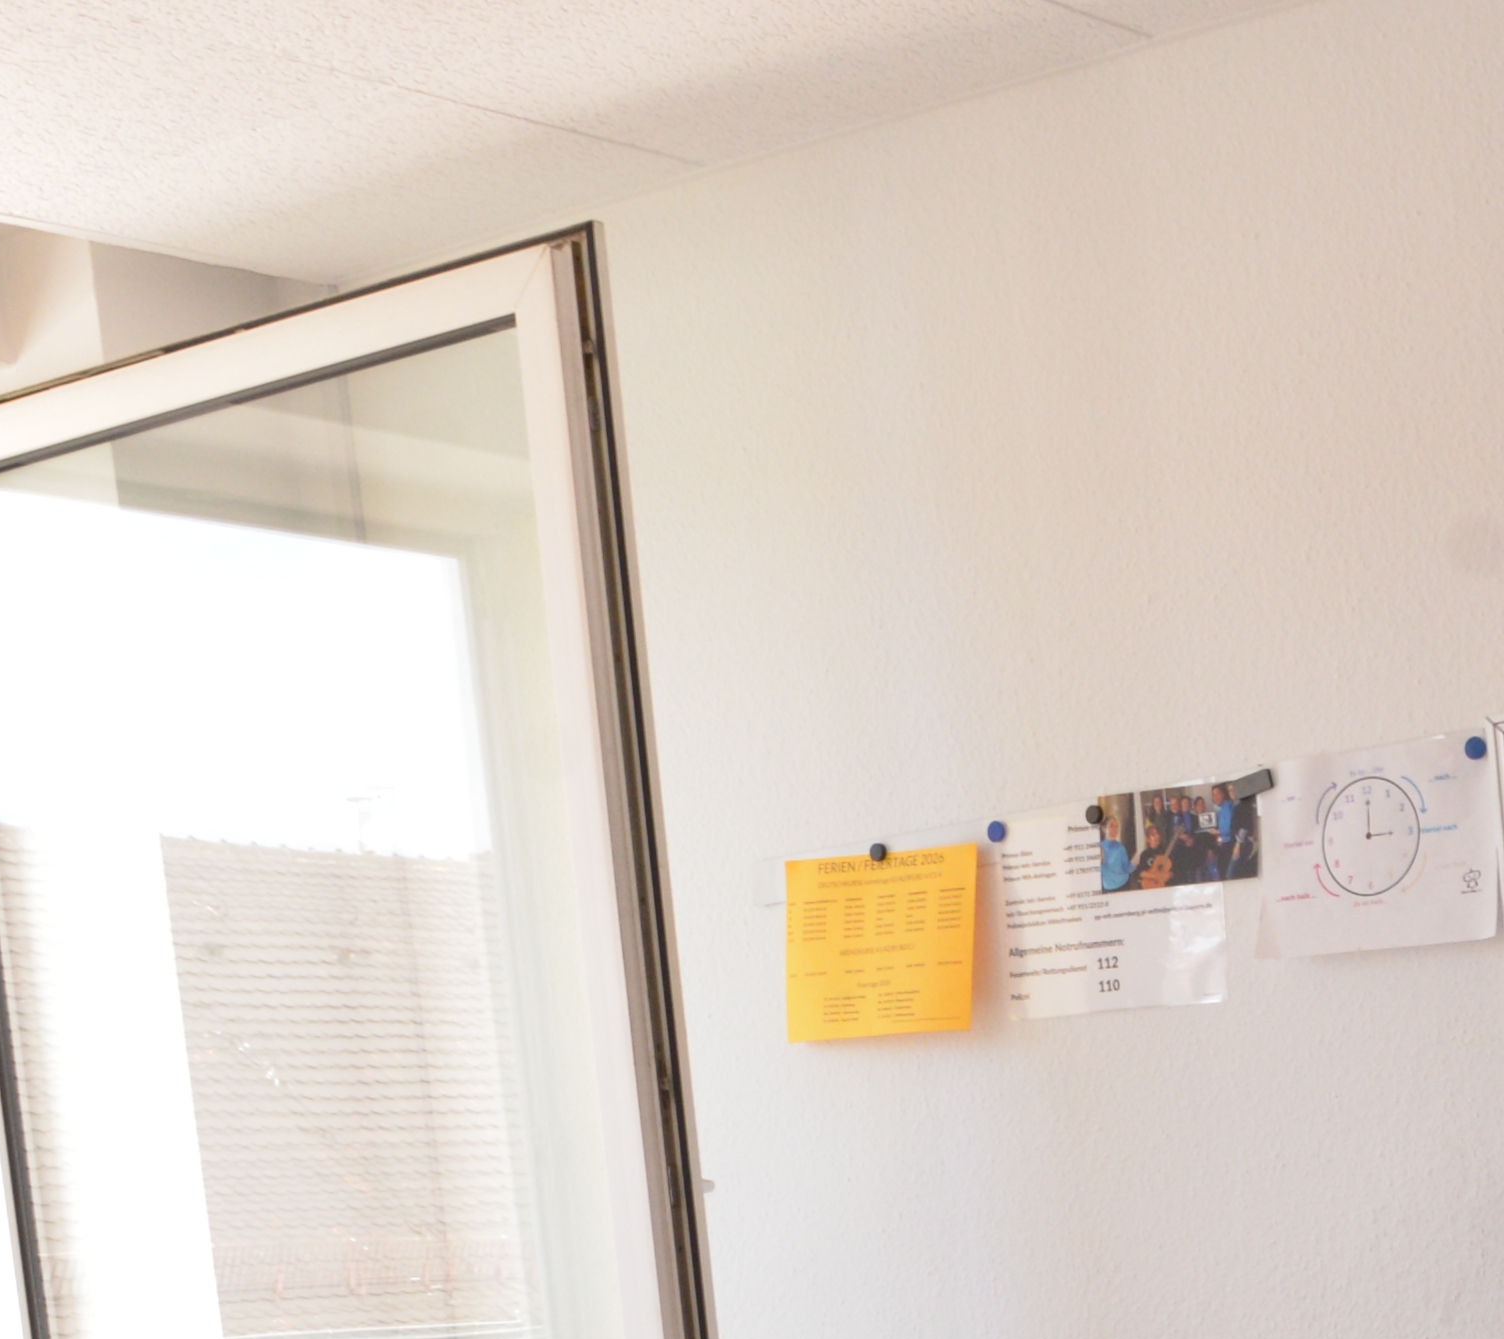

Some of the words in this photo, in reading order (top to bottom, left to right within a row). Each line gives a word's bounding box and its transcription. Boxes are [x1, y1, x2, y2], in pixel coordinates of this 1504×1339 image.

[818, 860, 855, 874] FERIEN
[1097, 955, 1119, 970] 112
[1098, 978, 1121, 993] 110
